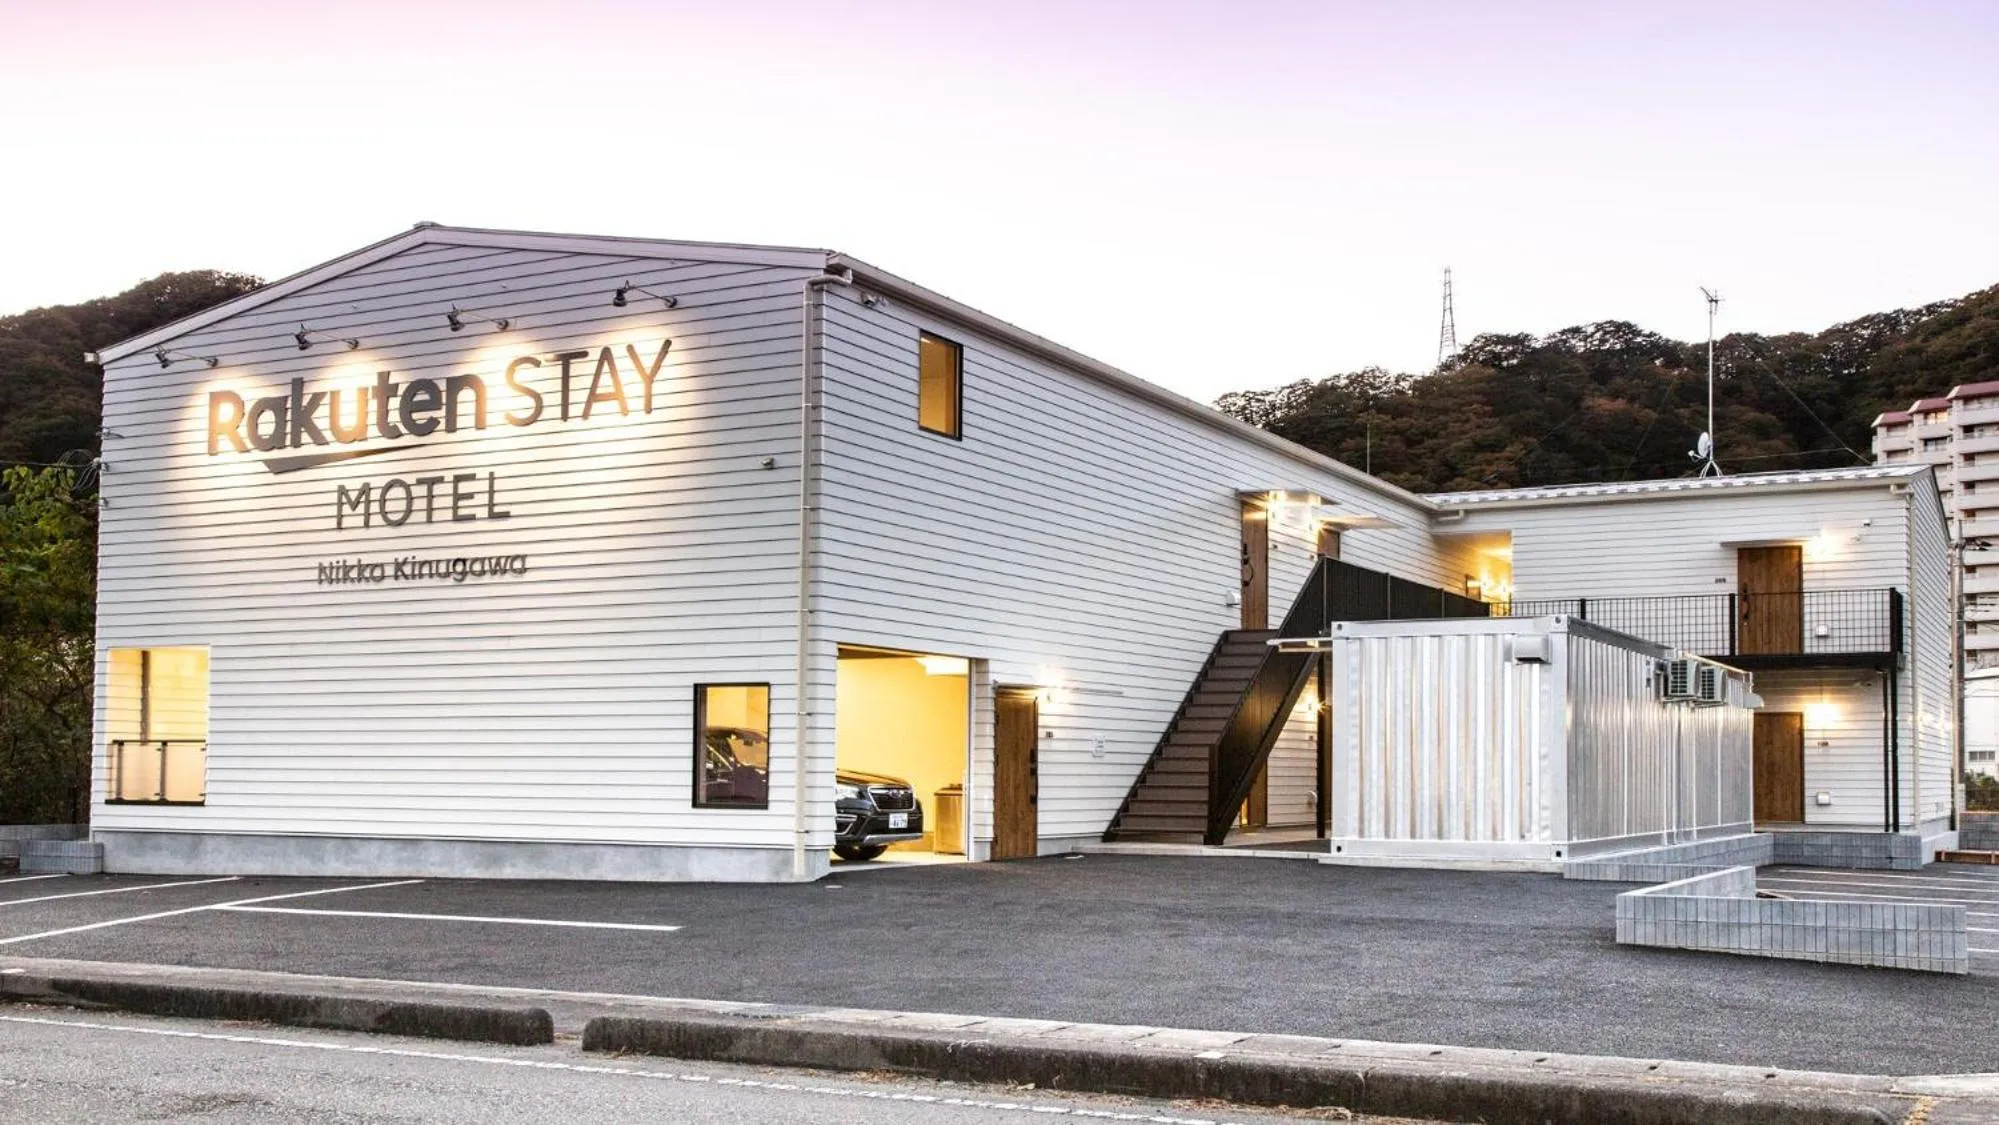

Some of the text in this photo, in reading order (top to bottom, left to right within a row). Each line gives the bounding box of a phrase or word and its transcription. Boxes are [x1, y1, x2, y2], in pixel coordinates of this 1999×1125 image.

[207, 339, 672, 456] Rakuten STAY
[336, 471, 511, 529] MOTEL
[318, 553, 528, 585] Nikko Kinugawa
